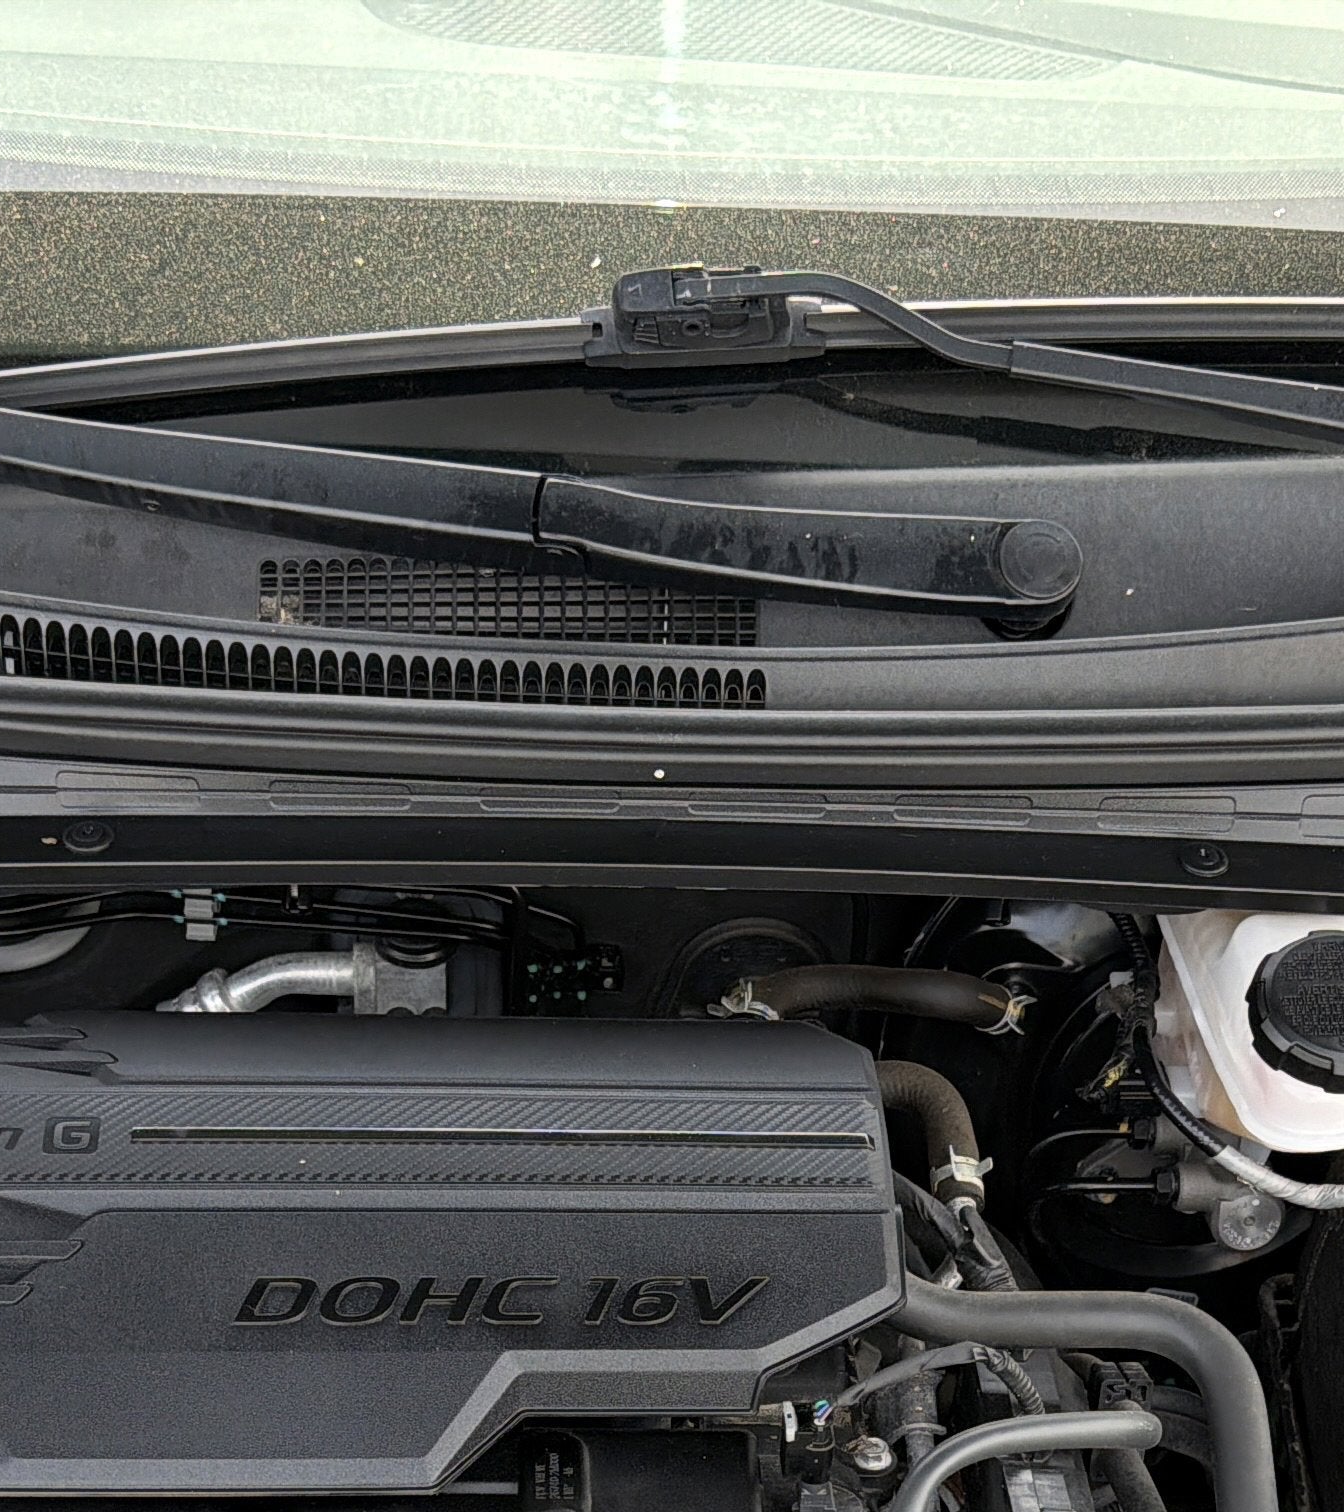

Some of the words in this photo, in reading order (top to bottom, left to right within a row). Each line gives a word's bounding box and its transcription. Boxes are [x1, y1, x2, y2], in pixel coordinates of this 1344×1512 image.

[46, 1119, 97, 1151] G
[233, 1274, 560, 1327] DOHC
[584, 1274, 773, 1327] 16V
